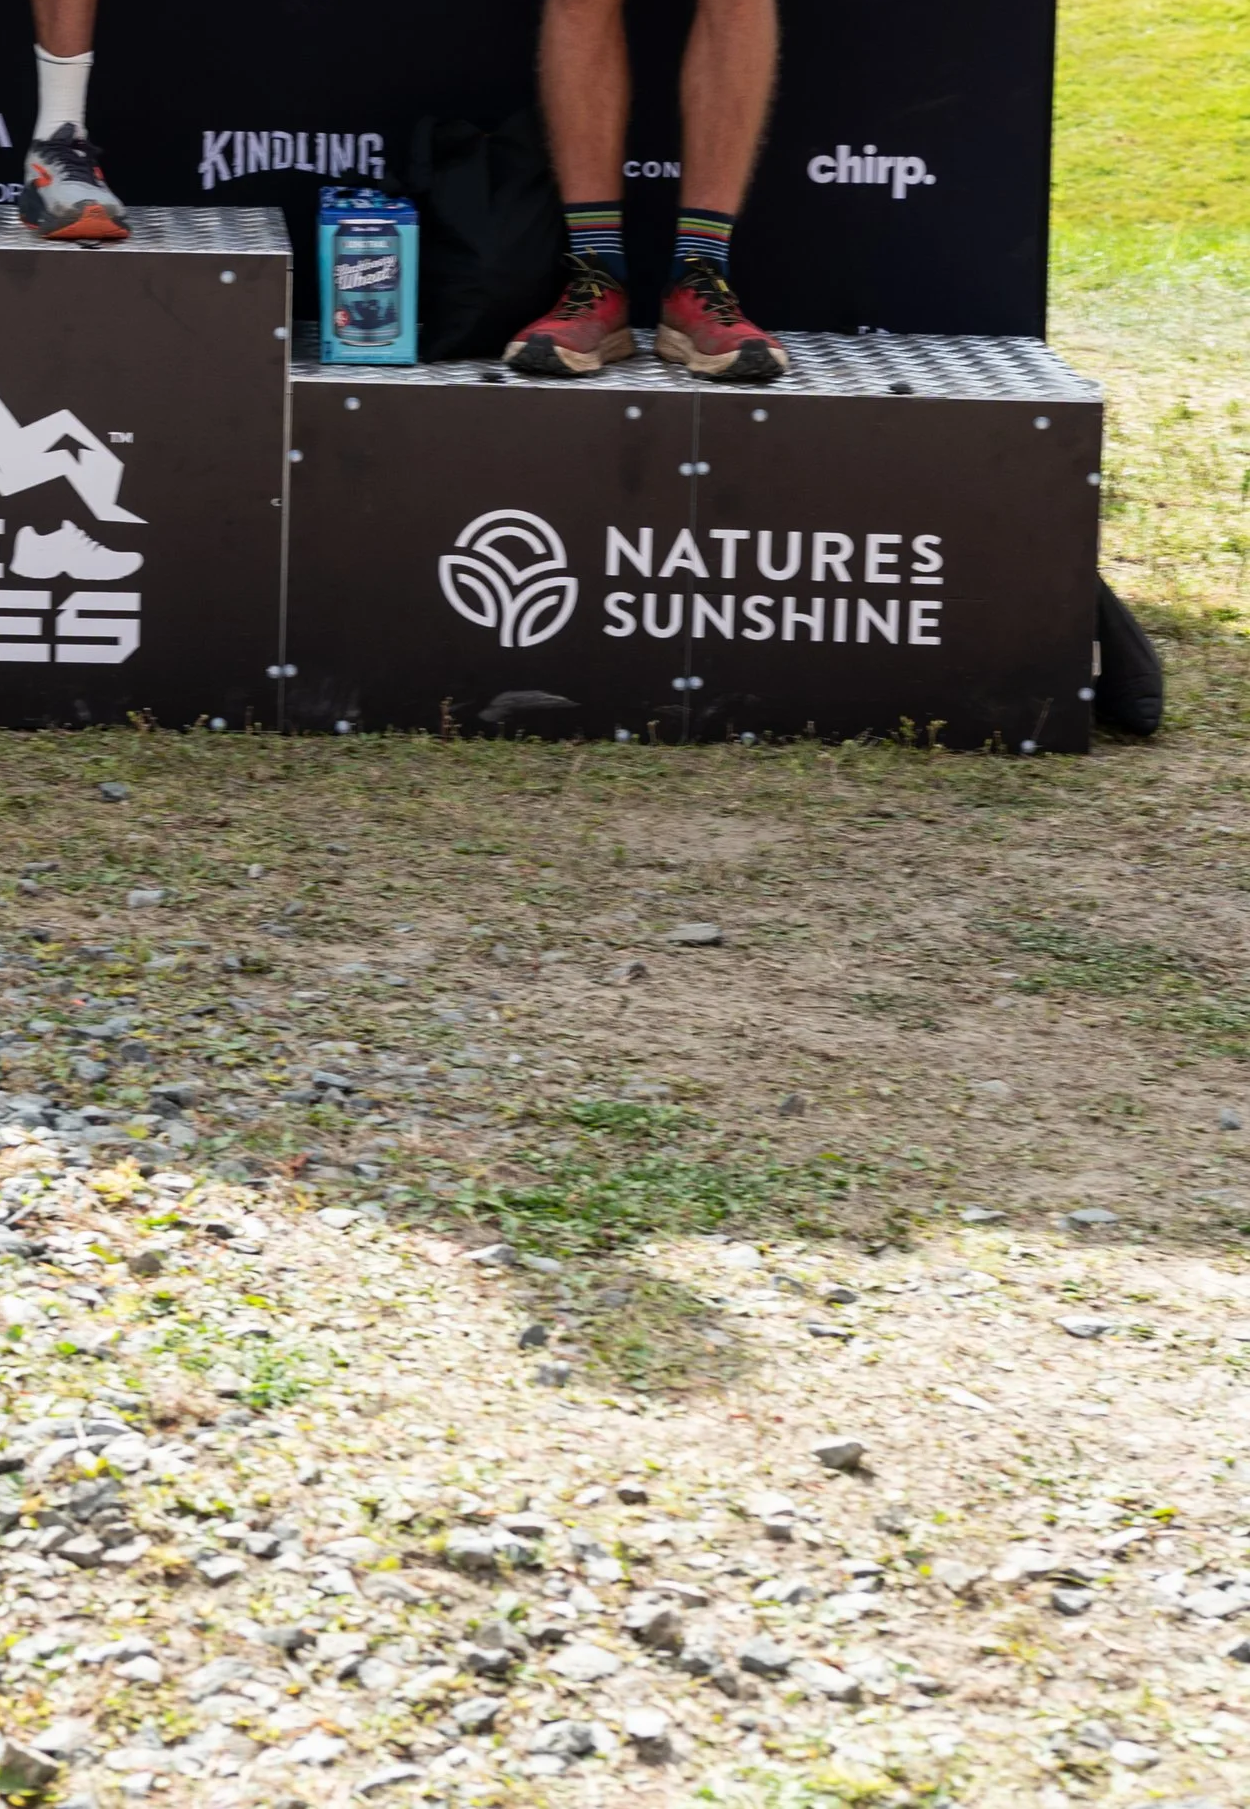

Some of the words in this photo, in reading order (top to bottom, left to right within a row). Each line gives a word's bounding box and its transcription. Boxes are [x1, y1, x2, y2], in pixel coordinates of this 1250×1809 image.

[198, 130, 386, 190] KINDLING
[807, 144, 937, 198] chirp.
[108, 432, 134, 443] TM
[605, 526, 944, 585] NATURES
[602, 591, 942, 646] SUNSHINE
